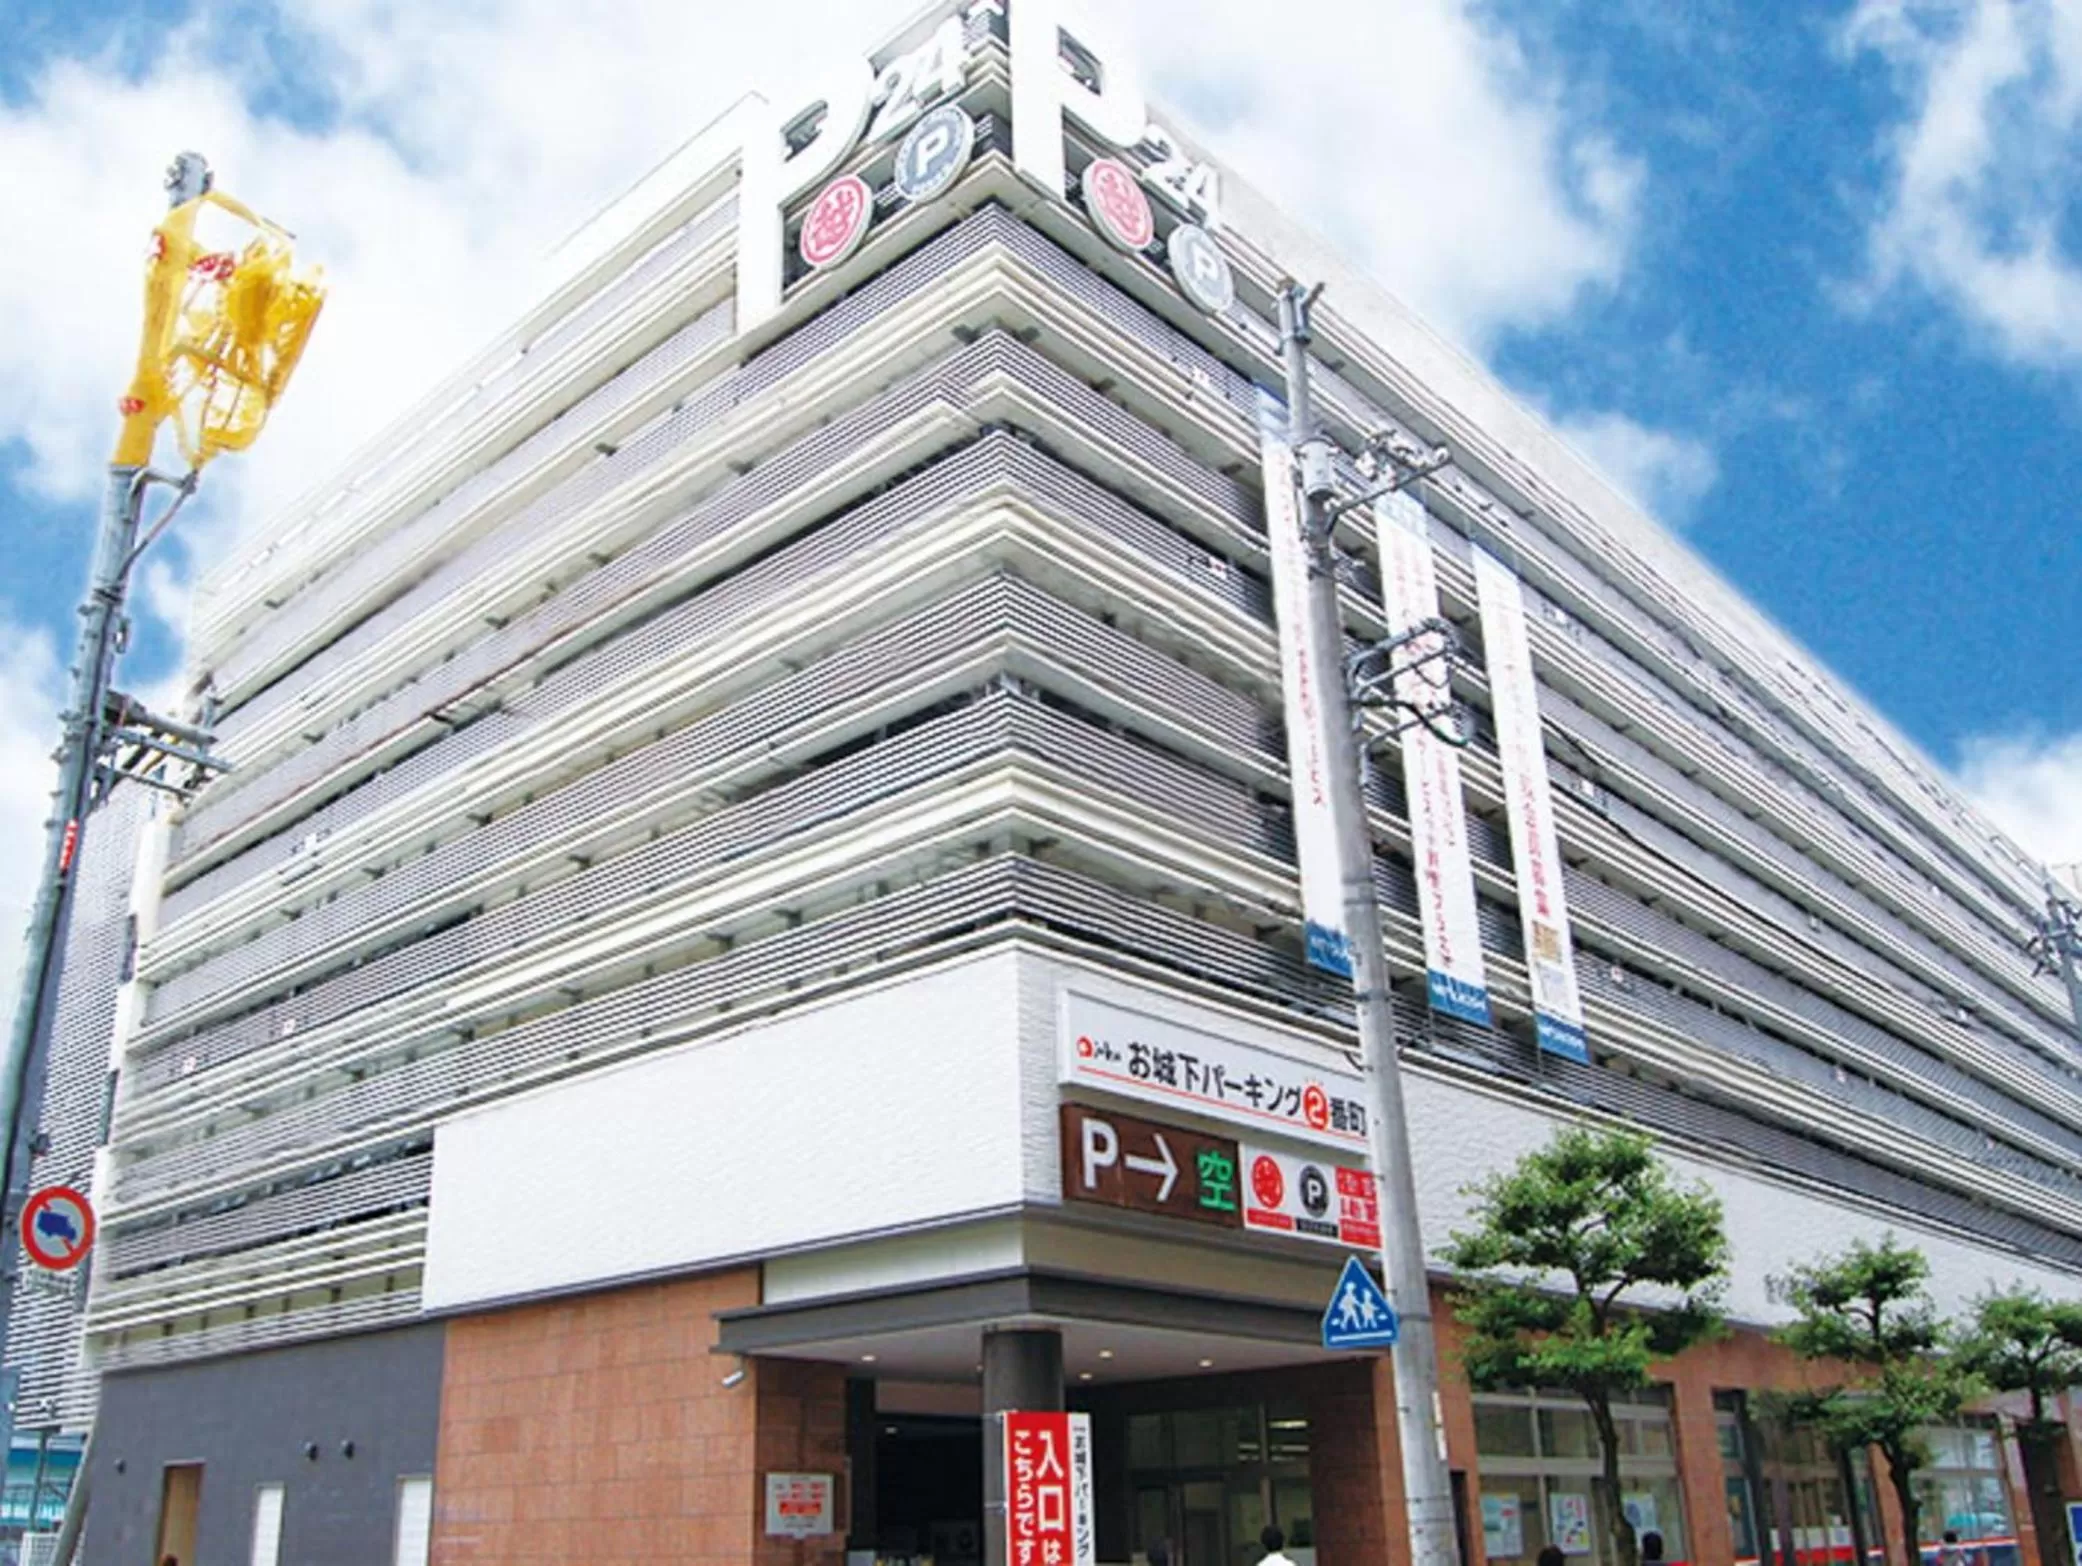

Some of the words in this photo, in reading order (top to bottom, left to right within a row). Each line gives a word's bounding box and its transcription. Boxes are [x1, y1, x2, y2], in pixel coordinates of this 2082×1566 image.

[1010, 0, 1146, 200] P
[1142, 123, 1221, 228] 24
[734, 55, 876, 334] P
[866, 14, 968, 146] 24
[916, 125, 949, 178] P
[1194, 245, 1220, 284] P
[1080, 1117, 1119, 1190] P
[1196, 1149, 1237, 1213] 空
[1307, 1179, 1322, 1205] P
[1013, 1429, 1036, 1566] こちらです
[1035, 1429, 1065, 1566] 入口は
